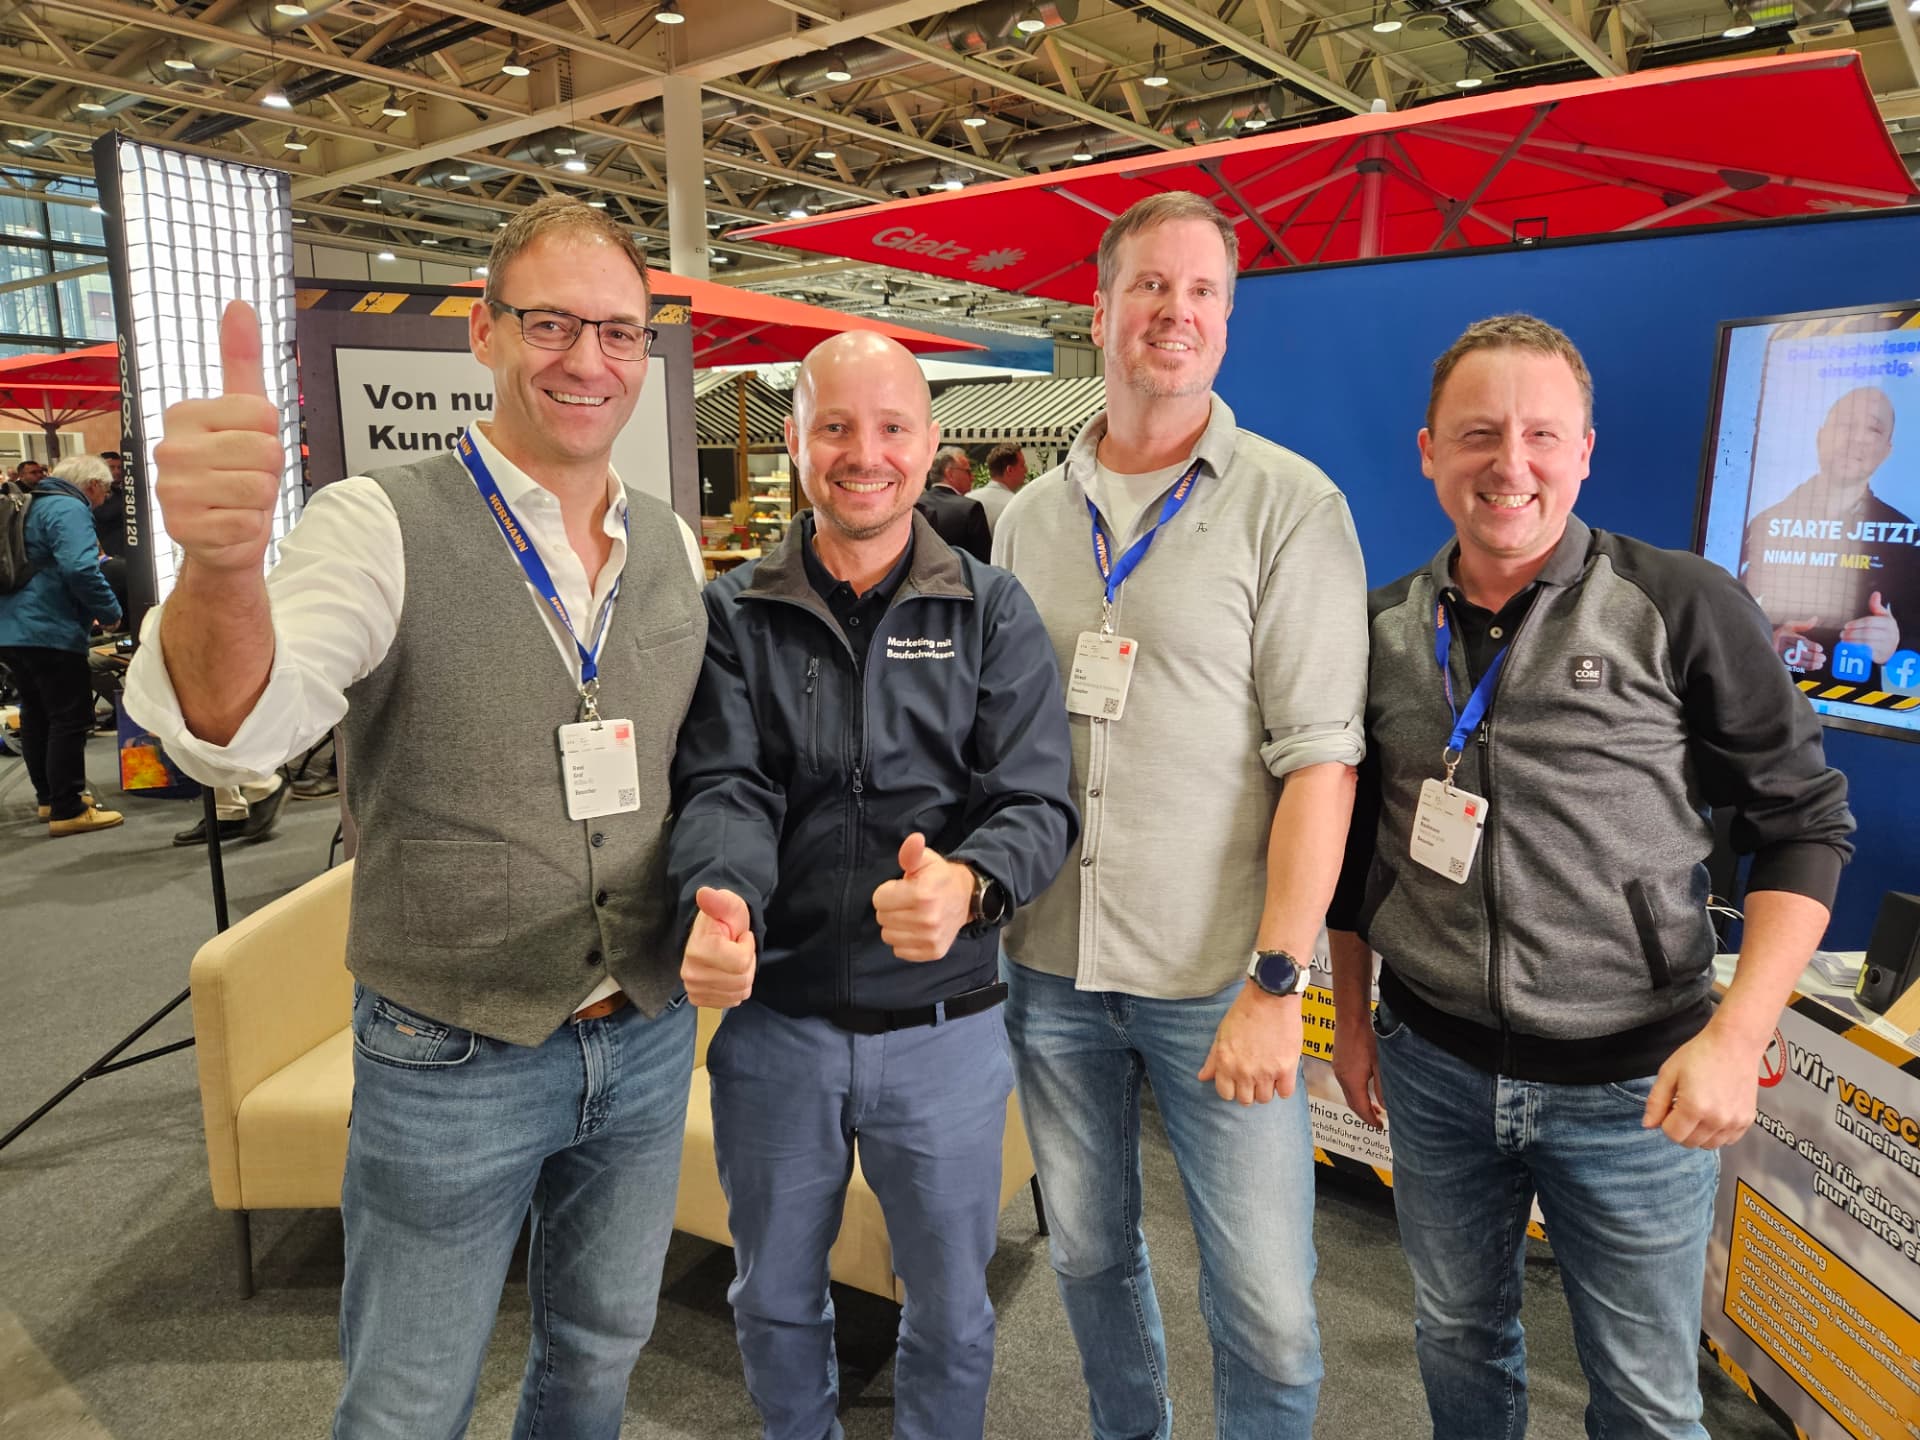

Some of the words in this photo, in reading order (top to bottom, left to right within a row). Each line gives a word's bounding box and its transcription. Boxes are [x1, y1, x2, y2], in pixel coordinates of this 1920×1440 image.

[872, 226, 971, 261] Glatz
[118, 333, 134, 440] Godox
[363, 384, 437, 410] Von
[123, 451, 138, 546] FL-SF30120
[1768, 518, 1843, 541] STARTE
[1763, 550, 1807, 566] NIMM
[1809, 552, 1838, 567] MIT
[1840, 553, 1871, 570] MIR
[886, 648, 955, 659] Baufachwissen
[887, 636, 936, 649] Marketing
[937, 638, 952, 648] mit
[1575, 670, 1600, 679] CORE
[1788, 1040, 1834, 1092] Wir
[1835, 1104, 1854, 1133] in
[1315, 1131, 1356, 1152] Bauleitung
[1798, 1138, 1834, 1177] dich
[1835, 1161, 1863, 1197] für
[1863, 1185, 1914, 1233] eines
[1743, 1192, 1827, 1272] Voraussetzung
[1813, 1171, 1848, 1211] (nur
[1848, 1196, 1902, 1251] heute
[1743, 1256, 1762, 1277] und
[1746, 1220, 1789, 1261] Experten
[1790, 1258, 1809, 1278] mit
[1809, 1271, 1878, 1335] langjähriger
[1879, 1330, 1903, 1356] Bau
[1739, 1288, 1813, 1361] Kundenakquise
[1741, 1272, 1767, 1300] Offen
[1768, 1295, 1783, 1313] für
[1783, 1311, 1829, 1356] digitales
[1829, 1351, 1898, 1418] Fachwissen
[1737, 1306, 1758, 1330] KMU
[1759, 1325, 1772, 1344] im
[1842, 1405, 1858, 1425] ab
